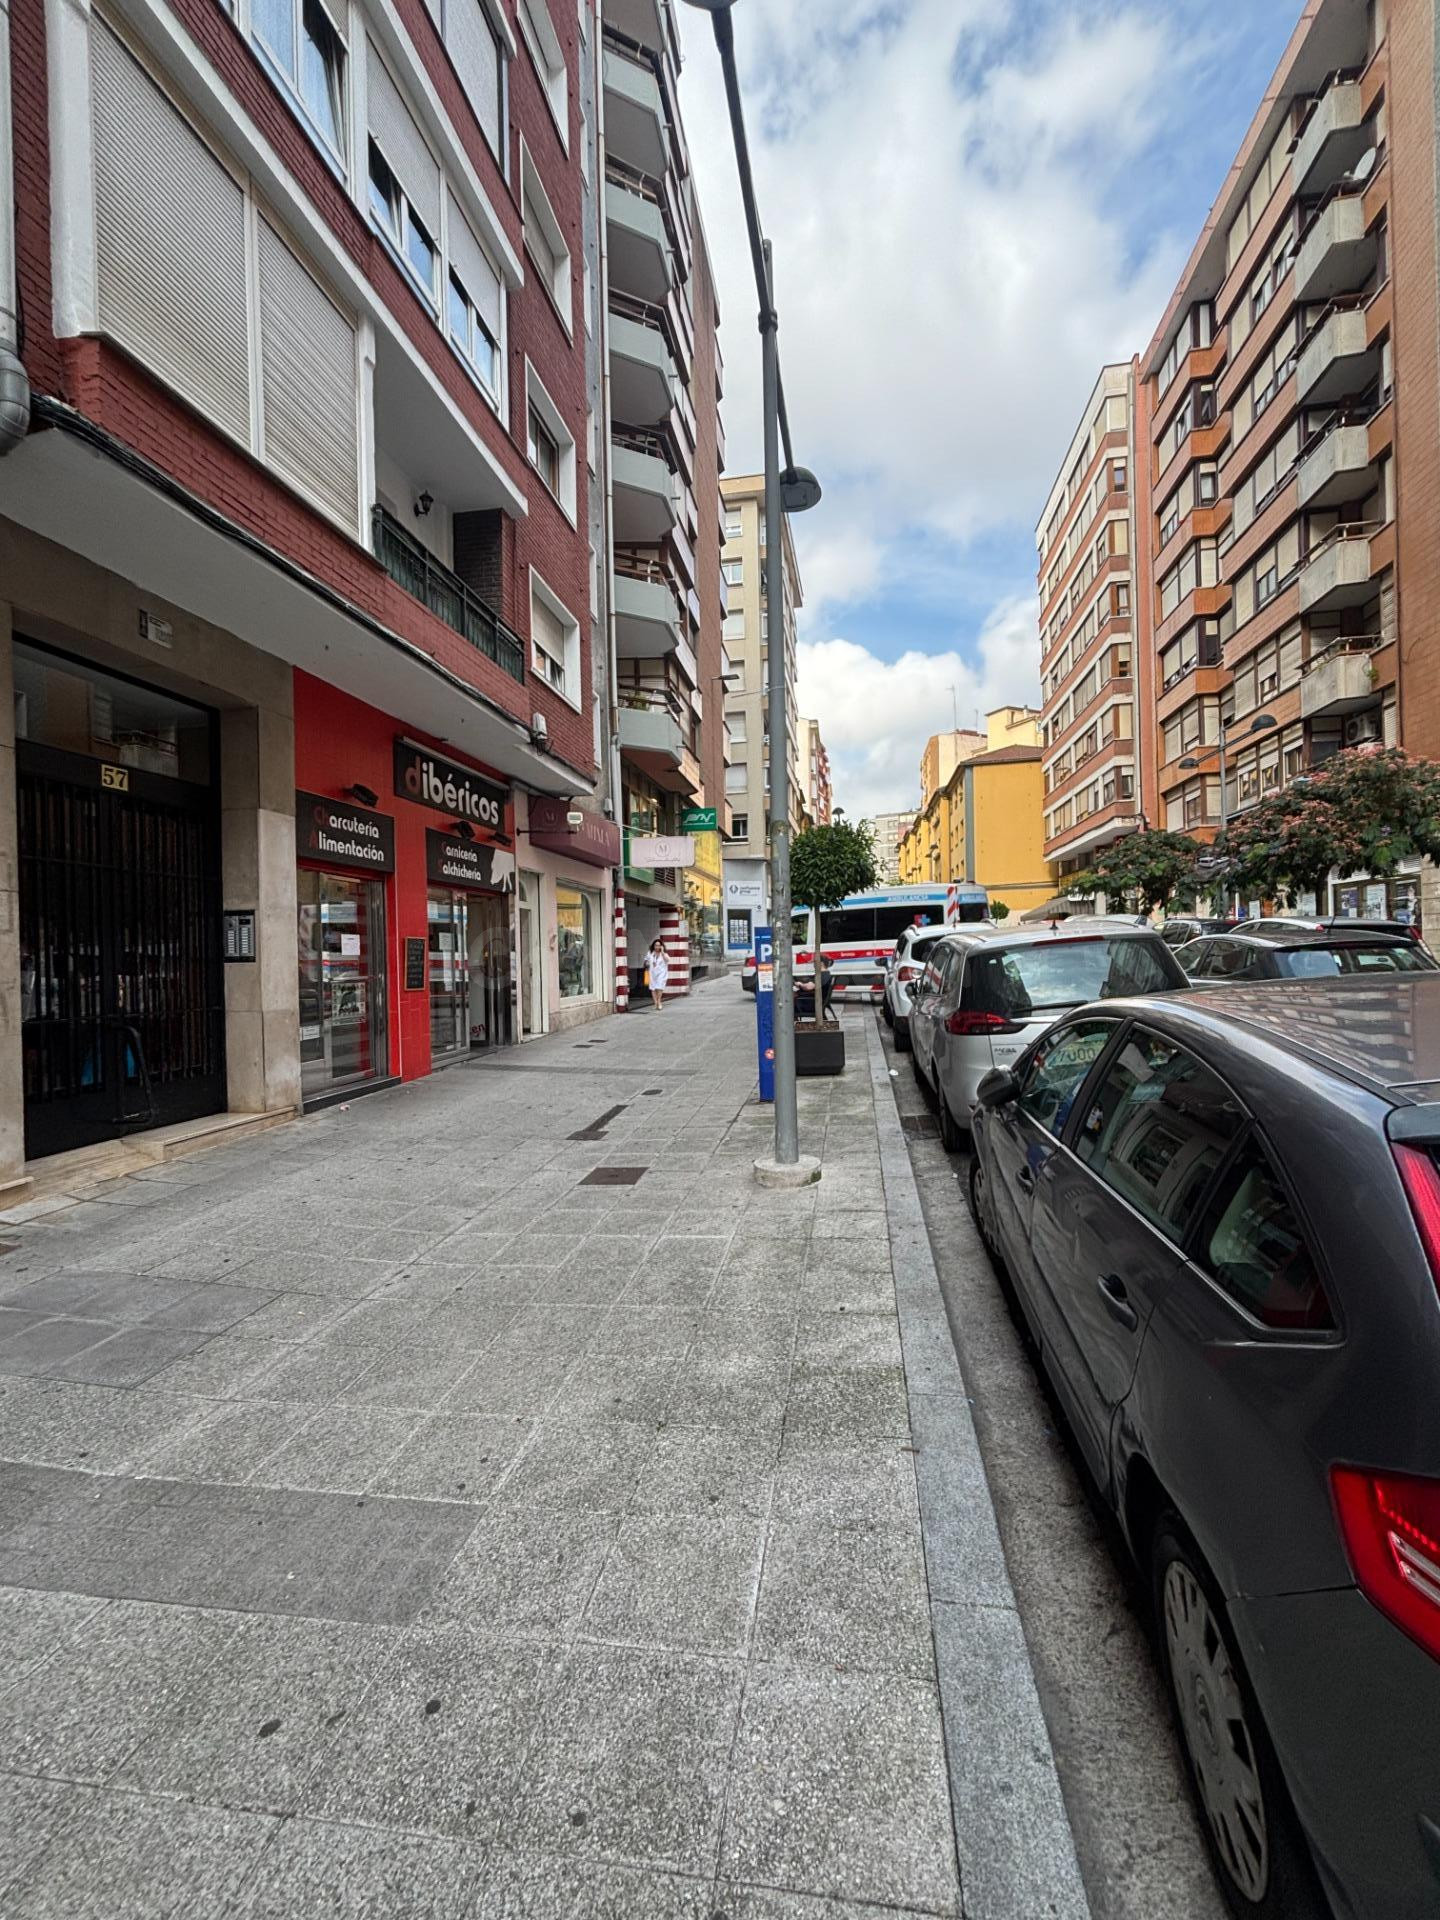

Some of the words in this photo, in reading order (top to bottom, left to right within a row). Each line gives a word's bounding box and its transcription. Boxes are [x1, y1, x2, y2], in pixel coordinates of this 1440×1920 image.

[103, 767, 127, 788] 57
[404, 756, 499, 825] dibéricos
[309, 829, 385, 862] Alimentación
[760, 943, 773, 962] P
